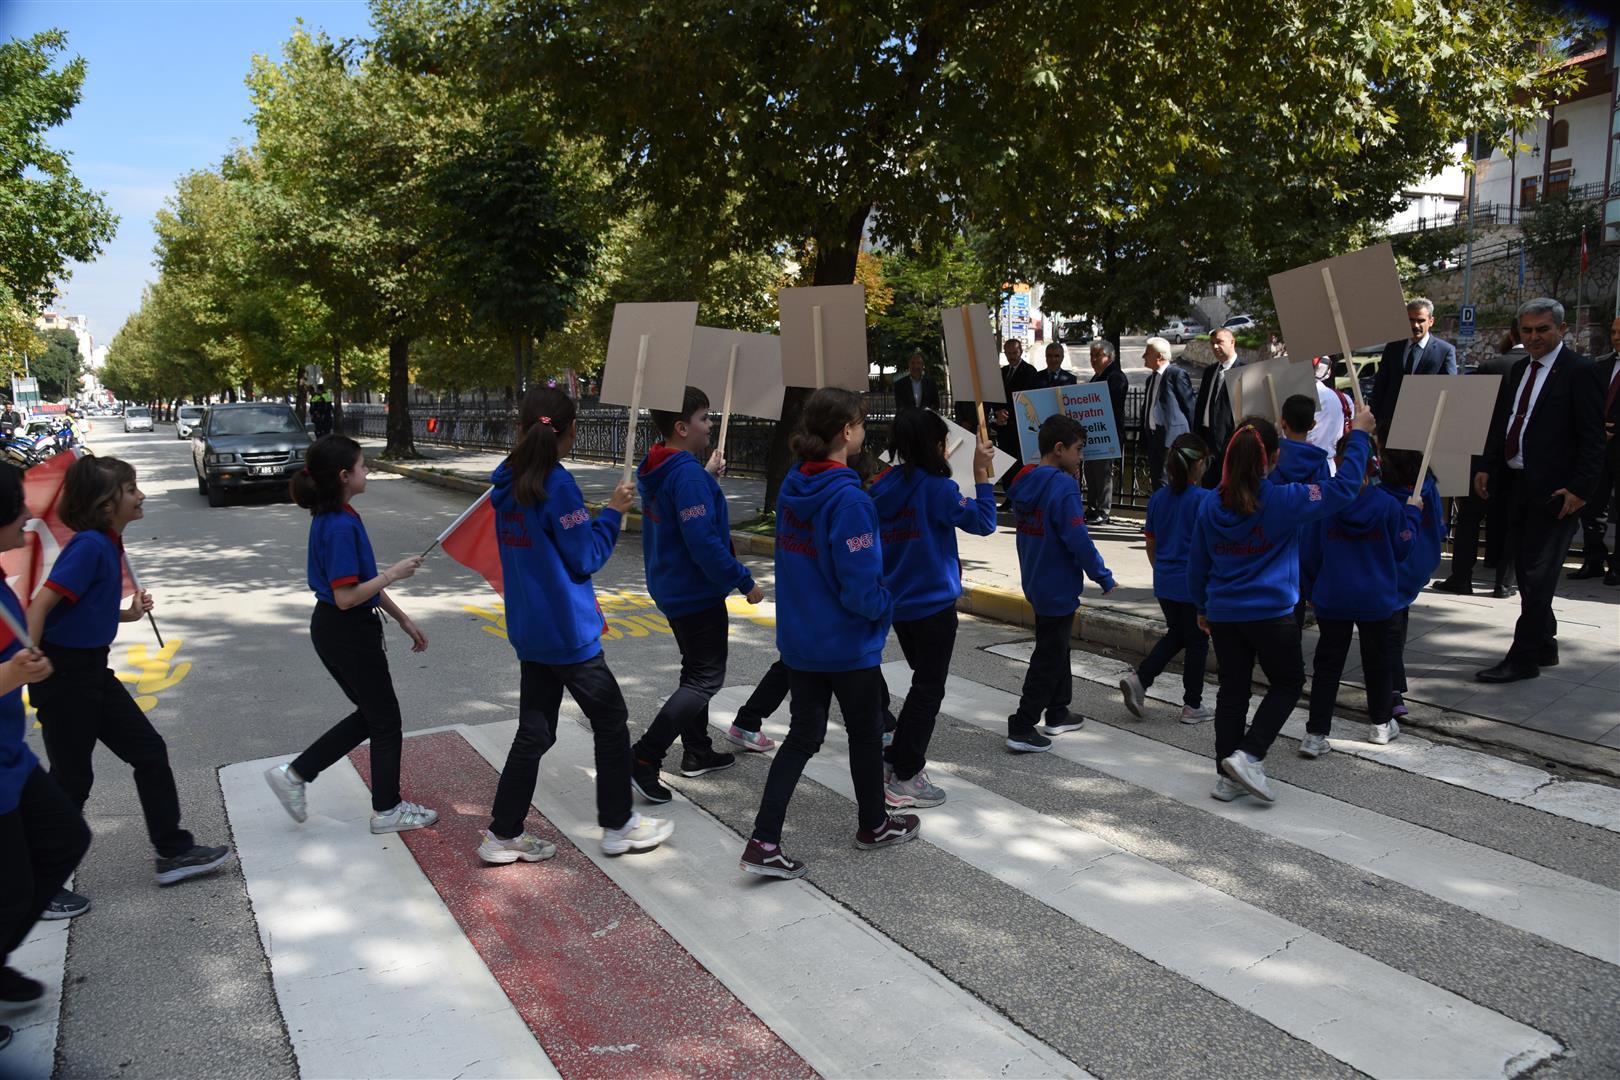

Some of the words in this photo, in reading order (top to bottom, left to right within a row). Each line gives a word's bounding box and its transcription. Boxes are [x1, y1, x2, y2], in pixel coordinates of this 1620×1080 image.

[1465, 310, 1472, 320] D
[1062, 393, 1101, 406] Öncelik
[1065, 408, 1104, 420] Hayatın
